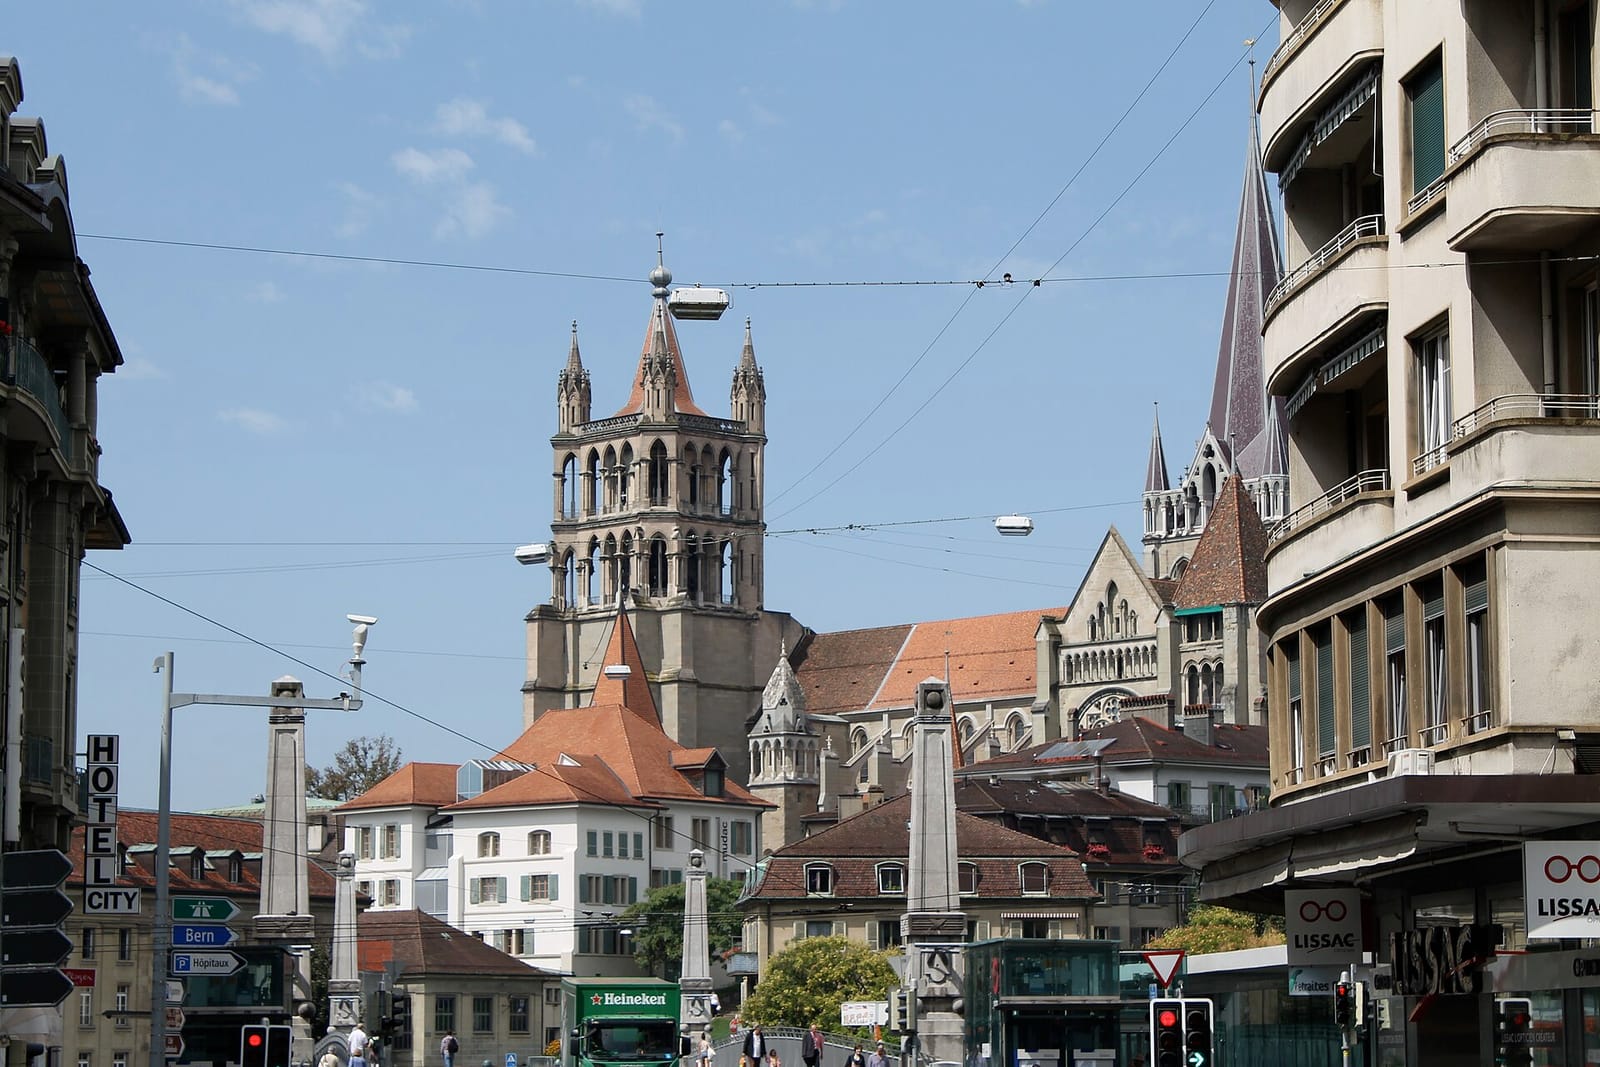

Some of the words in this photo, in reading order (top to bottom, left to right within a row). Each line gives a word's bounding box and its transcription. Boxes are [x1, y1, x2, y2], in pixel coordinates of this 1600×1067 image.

[91, 736, 114, 884] HOTEL
[721, 820, 729, 862] mudac
[87, 891, 138, 910] CITY
[1538, 898, 1600, 917] LISSA
[185, 928, 215, 943] Bern
[1294, 932, 1356, 949] LISSAC
[193, 956, 229, 970] Hôpitaux
[604, 993, 666, 1005] Heineken
